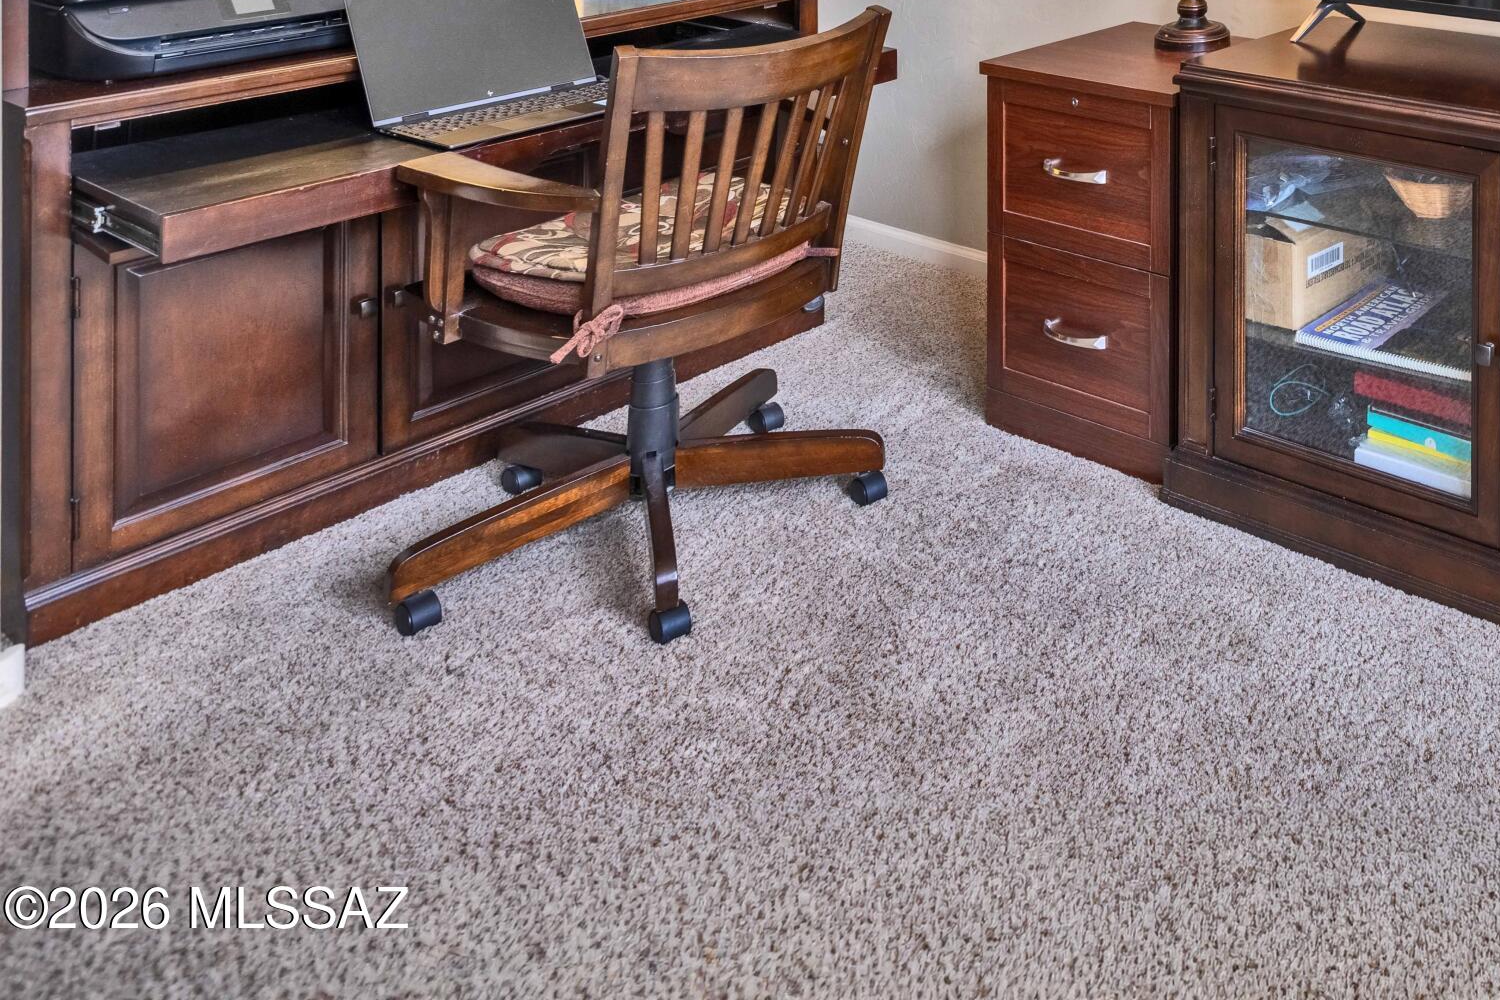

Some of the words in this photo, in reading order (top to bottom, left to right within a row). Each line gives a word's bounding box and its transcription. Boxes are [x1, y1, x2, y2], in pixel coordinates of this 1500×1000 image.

[1322, 314, 1357, 335] NORTH
[1355, 286, 1400, 315] AMERICAN
[1333, 315, 1386, 341] ROAD
